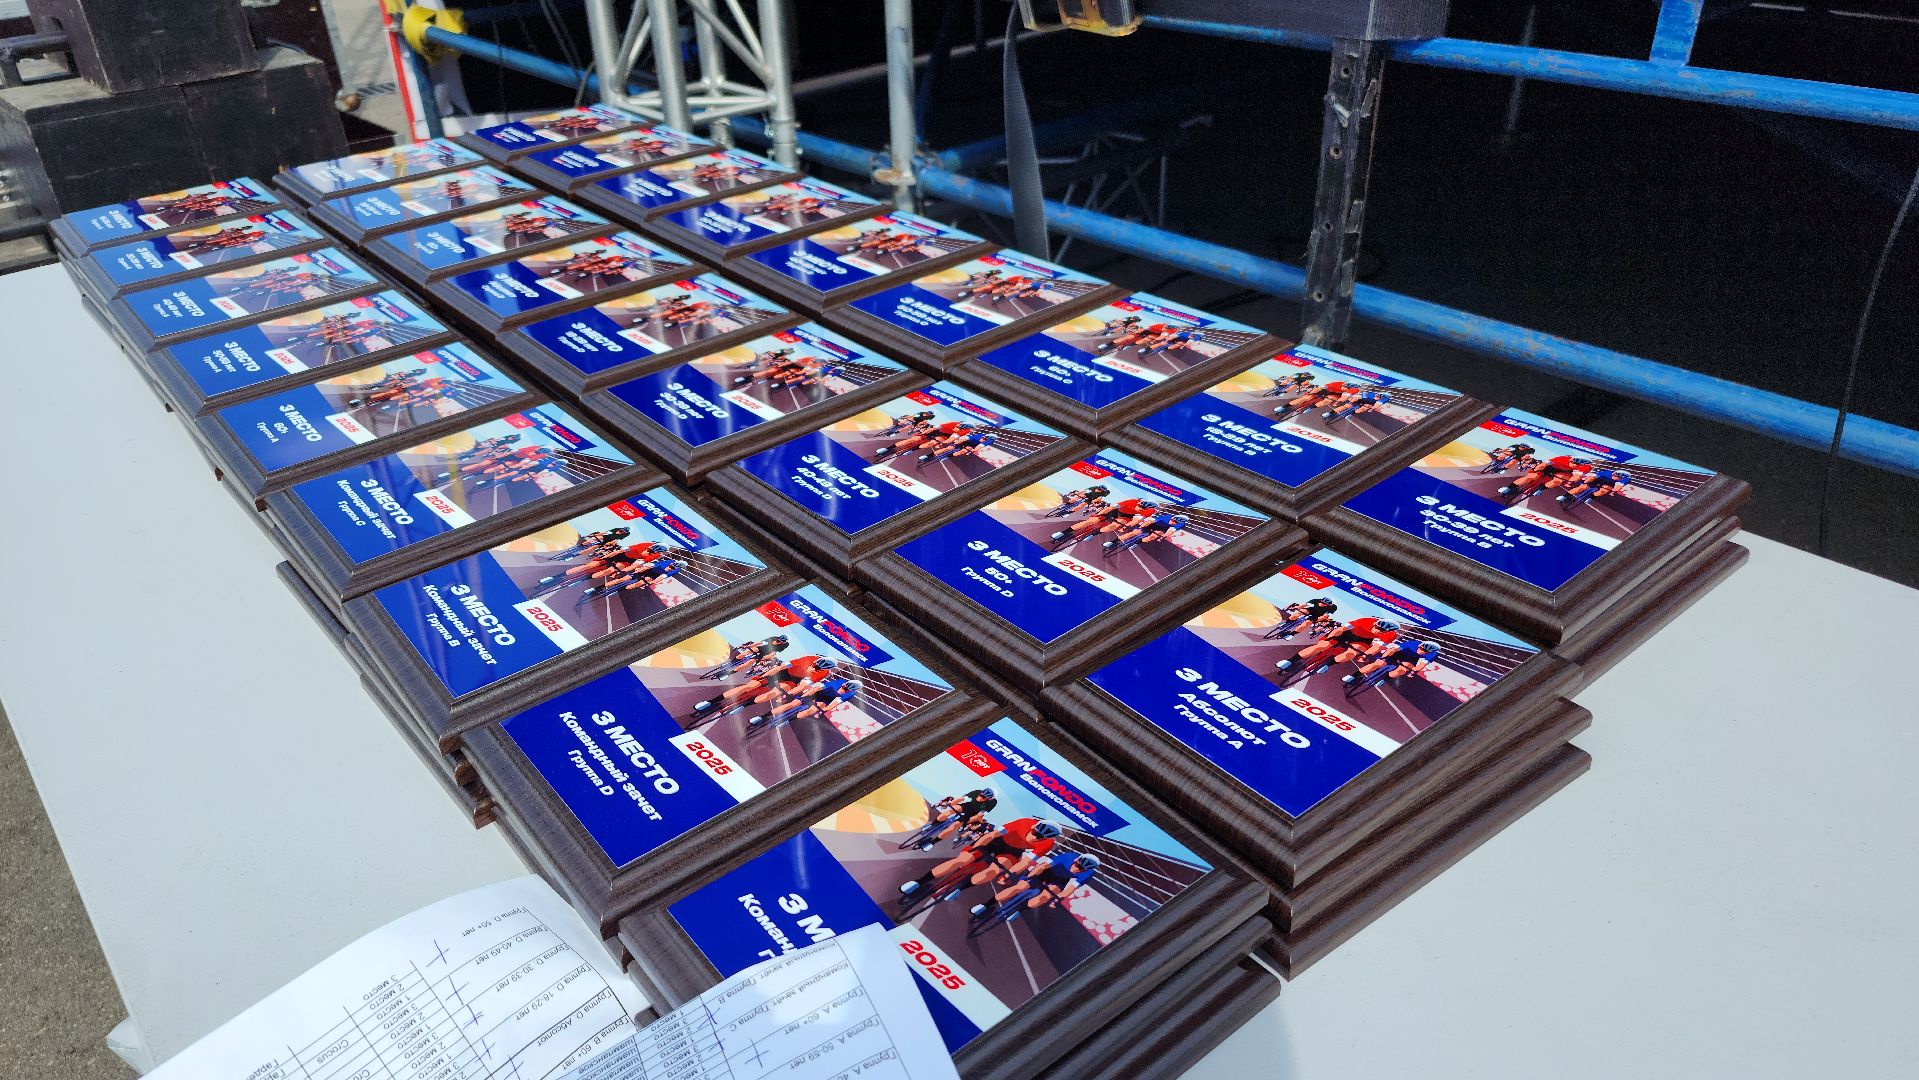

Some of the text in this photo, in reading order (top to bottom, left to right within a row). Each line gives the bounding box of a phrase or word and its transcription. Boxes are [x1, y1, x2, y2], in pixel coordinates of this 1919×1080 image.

[911, 303, 964, 324] МЕСТО
[580, 328, 623, 351] МЕСТО
[229, 347, 260, 371] МЕСТО
[1047, 356, 1112, 381] МЕСТО
[677, 389, 730, 418] МЕСТО
[280, 404, 322, 441] 3 МЕСТО
[1201, 414, 1302, 452] 3 МЕСТО
[1504, 420, 1609, 452] GRANFONDO
[792, 476, 823, 495] Группа
[797, 468, 832, 487] 40-49
[802, 455, 879, 497] 3 МЕСТО
[1096, 460, 1182, 495] GRANFONDO
[337, 480, 396, 538] Командный зачет
[338, 501, 359, 521] Группа
[361, 479, 413, 524] 3 МЕСТО
[427, 496, 454, 513] 2025
[638, 500, 700, 539] GRANFONDO
[1416, 496, 1545, 546] 3 МЕСТО
[1420, 510, 1514, 547] 30-39 лет
[1423, 520, 1476, 543] Группа
[961, 567, 1001, 591] Группа
[968, 541, 1067, 595] 3 МЕСТО
[985, 567, 1012, 584] 50+
[1058, 560, 1105, 581] 2025
[1312, 564, 1424, 614] GRANFONDO
[451, 585, 515, 645] 3 МЕСТО
[1351, 587, 1431, 624] Волоколамск
[423, 585, 497, 664] Командный зачет
[426, 613, 452, 640] Группа
[527, 607, 563, 631] 2025
[790, 600, 870, 652] GRANFONDO
[813, 624, 868, 662] Волоколамск
[1176, 668, 1310, 748] 3 МЕСТО
[1178, 694, 1266, 744] Абсолют
[1291, 699, 1356, 730] 2025
[1174, 704, 1243, 749] Группа A
[592, 711, 679, 794] 3 МЕСТО
[686, 742, 732, 775] 2025
[559, 712, 662, 820] Командный зачет
[568, 750, 614, 795] Группа D
[986, 740, 1096, 813] GRANFONDO
[1020, 773, 1098, 828] Волоколамск
[778, 893, 809, 915] 3
[738, 893, 797, 955] Коман
[511, 964, 533, 981] 30-39
[564, 965, 591, 984] Группа
[800, 963, 848, 992] Командный
[900, 940, 966, 992] 2025
[363, 980, 389, 1000] место
[496, 979, 509, 992] лет
[727, 978, 756, 997] Группа
[370, 990, 396, 1010] место
[377, 1000, 402, 1020] место
[785, 986, 863, 1034] Группа 60+ лет
[384, 1008, 409, 1029] место
[516, 1007, 529, 1020] лет
[538, 991, 611, 1046] Группа Абсолют
[651, 1014, 676, 1031] место
[736, 1005, 769, 1024] Группа
[391, 1018, 416, 1039] место
[398, 1028, 423, 1048] место
[654, 1022, 680, 1040] место
[657, 1031, 683, 1049] место
[317, 1040, 349, 1063] Crocus
[405, 1038, 430, 1058] место
[563, 1018, 629, 1069] Группа 60+ лет
[660, 1040, 686, 1058] место
[791, 1016, 879, 1069] Группа 50-59 лет
[412, 1048, 437, 1069] место
[419, 1058, 444, 1079] место
[579, 1040, 633, 1074] шампанское
[664, 1050, 690, 1068] место
[667, 1060, 694, 1078] место
[861, 1048, 896, 1069] Группа
